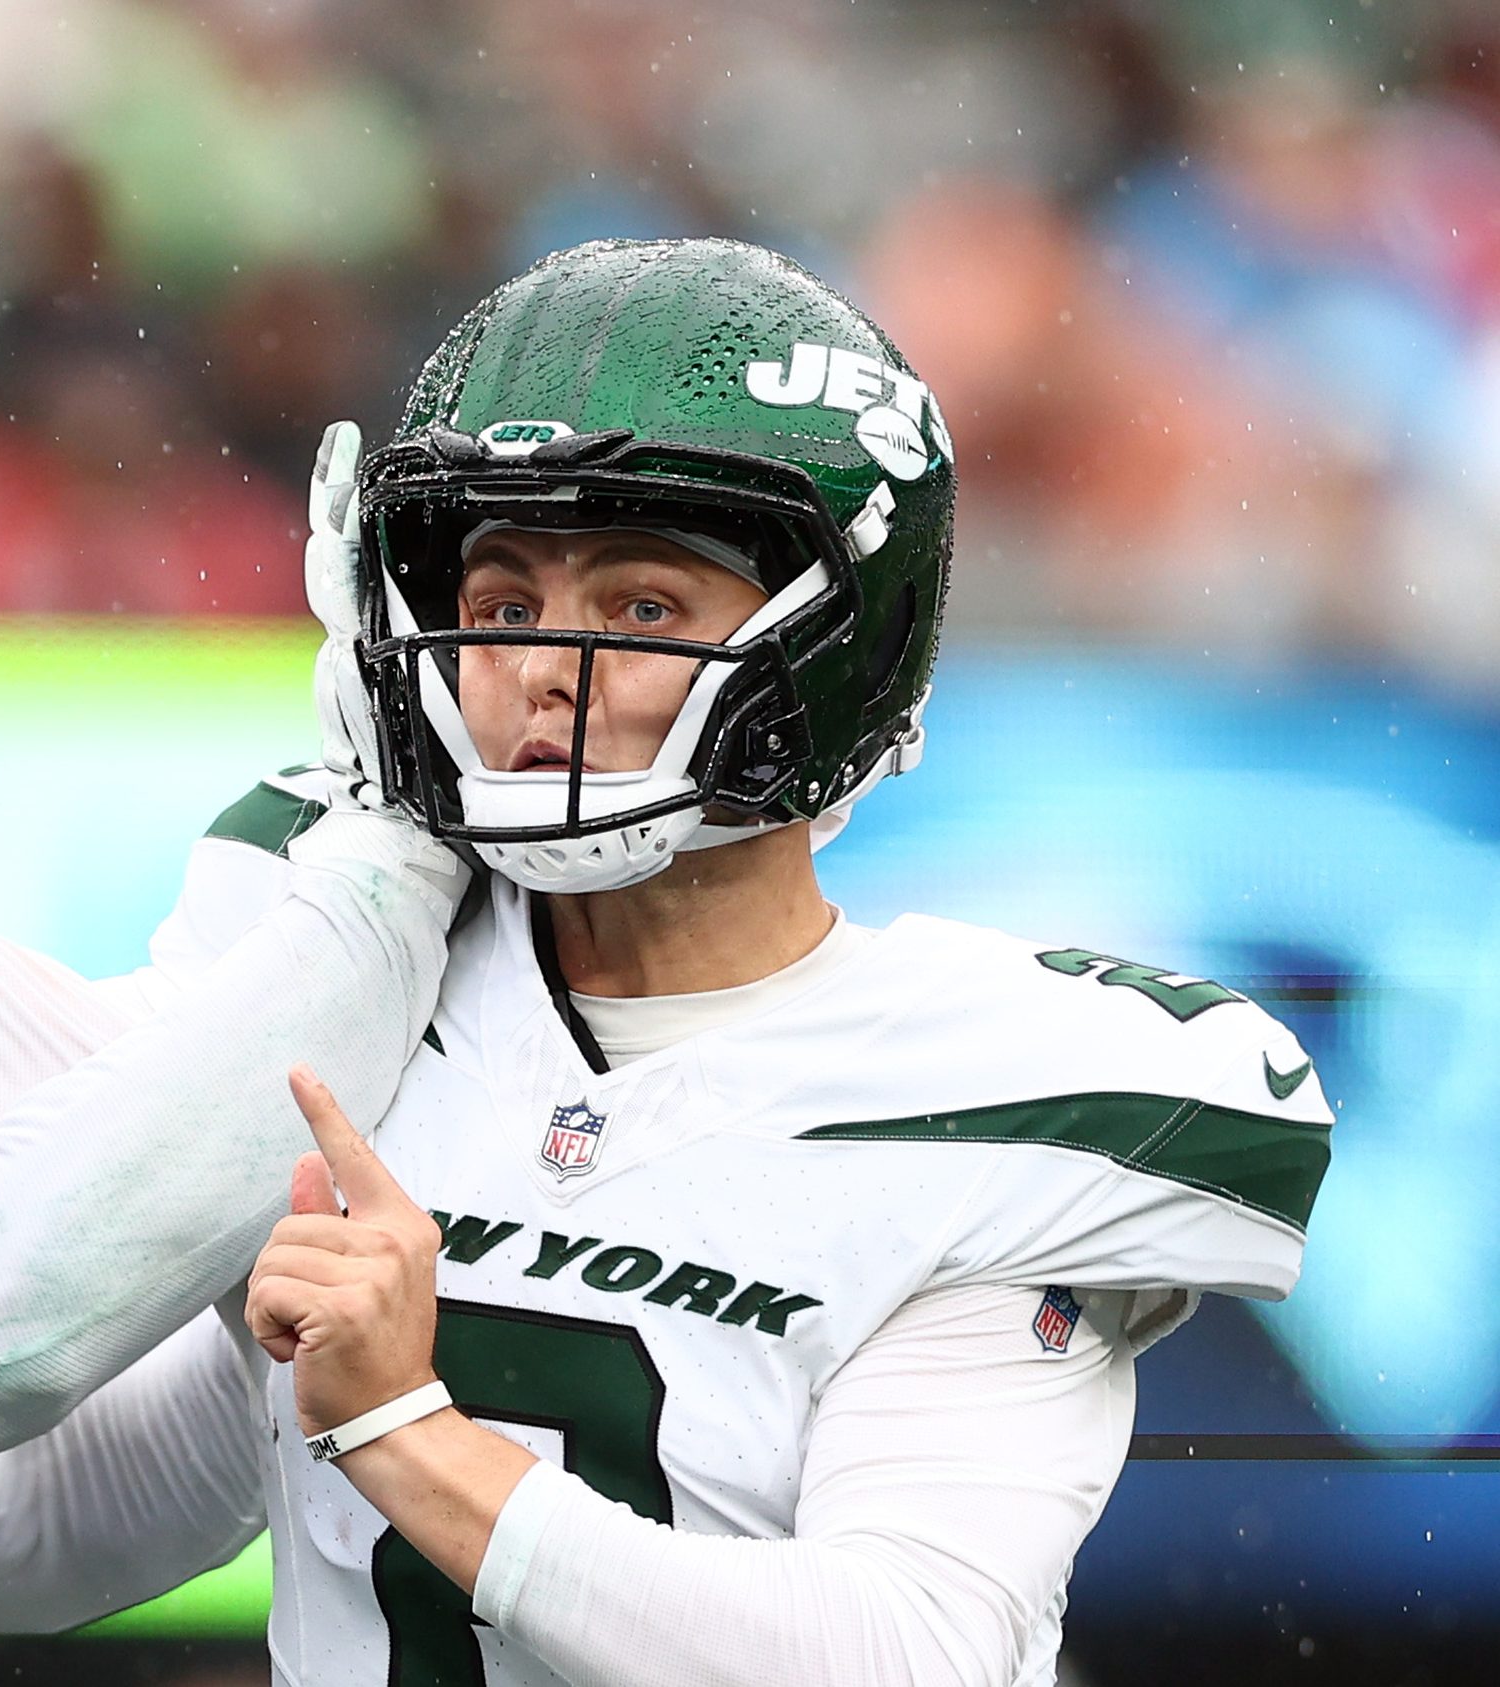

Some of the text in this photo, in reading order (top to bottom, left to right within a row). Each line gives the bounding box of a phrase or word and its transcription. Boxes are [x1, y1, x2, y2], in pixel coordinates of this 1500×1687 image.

[491, 424, 556, 443] JETS
[1034, 948, 1248, 1023] 2
[546, 1129, 589, 1165] NFL
[522, 1231, 824, 1337] YORK
[1036, 1303, 1070, 1349] NFL
[306, 1433, 341, 1461] OME
